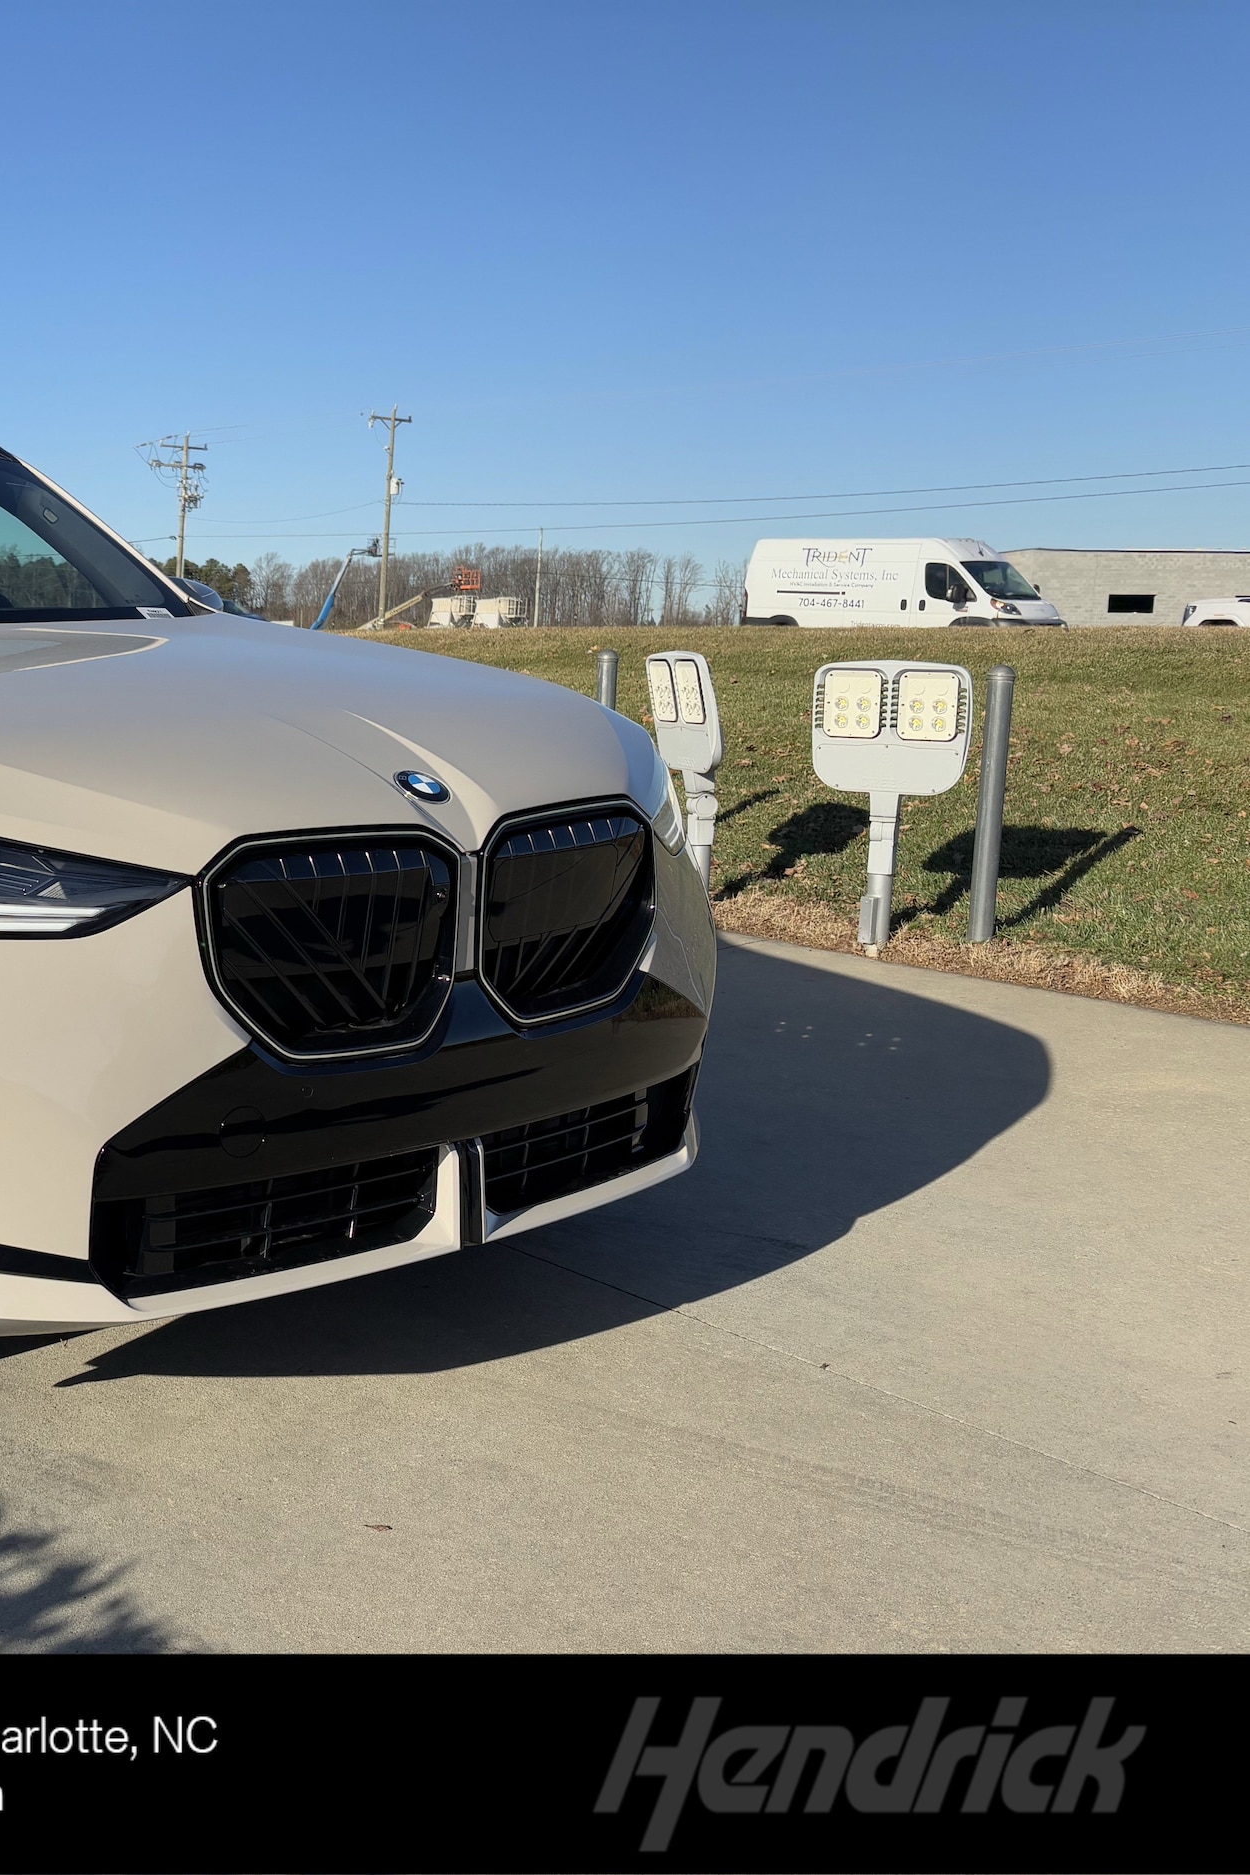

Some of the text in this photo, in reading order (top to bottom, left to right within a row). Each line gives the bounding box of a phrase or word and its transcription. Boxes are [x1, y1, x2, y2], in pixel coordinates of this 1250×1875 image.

[802, 548, 873, 568] TRIDENT
[771, 567, 899, 583] Mechanical Systems, Inc
[798, 597, 865, 608] 704-467-8441
